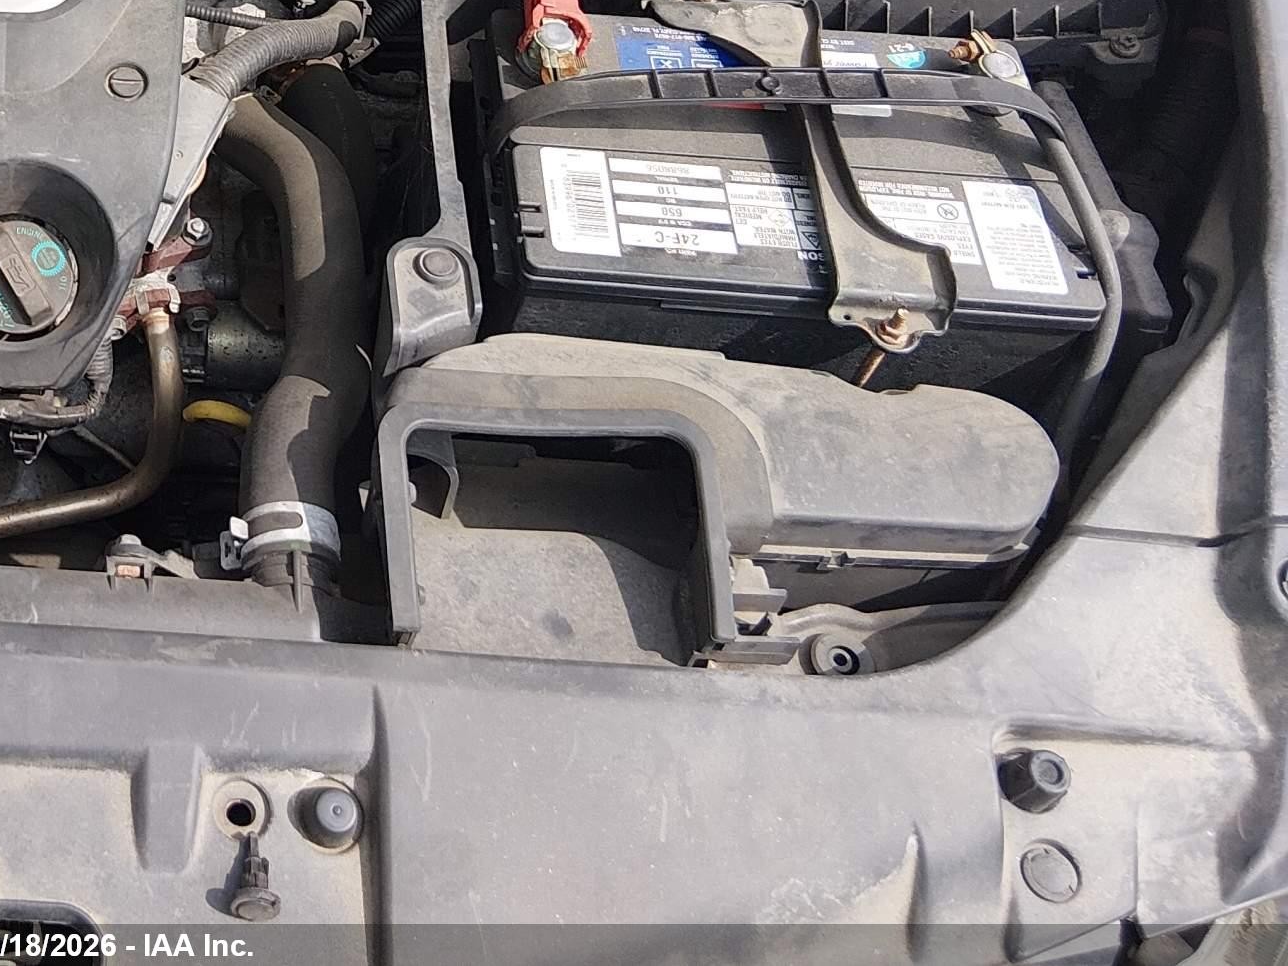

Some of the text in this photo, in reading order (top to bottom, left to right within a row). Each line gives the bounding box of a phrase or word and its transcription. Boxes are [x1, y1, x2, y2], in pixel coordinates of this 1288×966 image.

[657, 185, 679, 196] 110
[661, 206, 683, 219] 650
[16, 226, 44, 240] ENGINE
[654, 230, 701, 247] 24F-C
[57, 275, 68, 291] OIL
